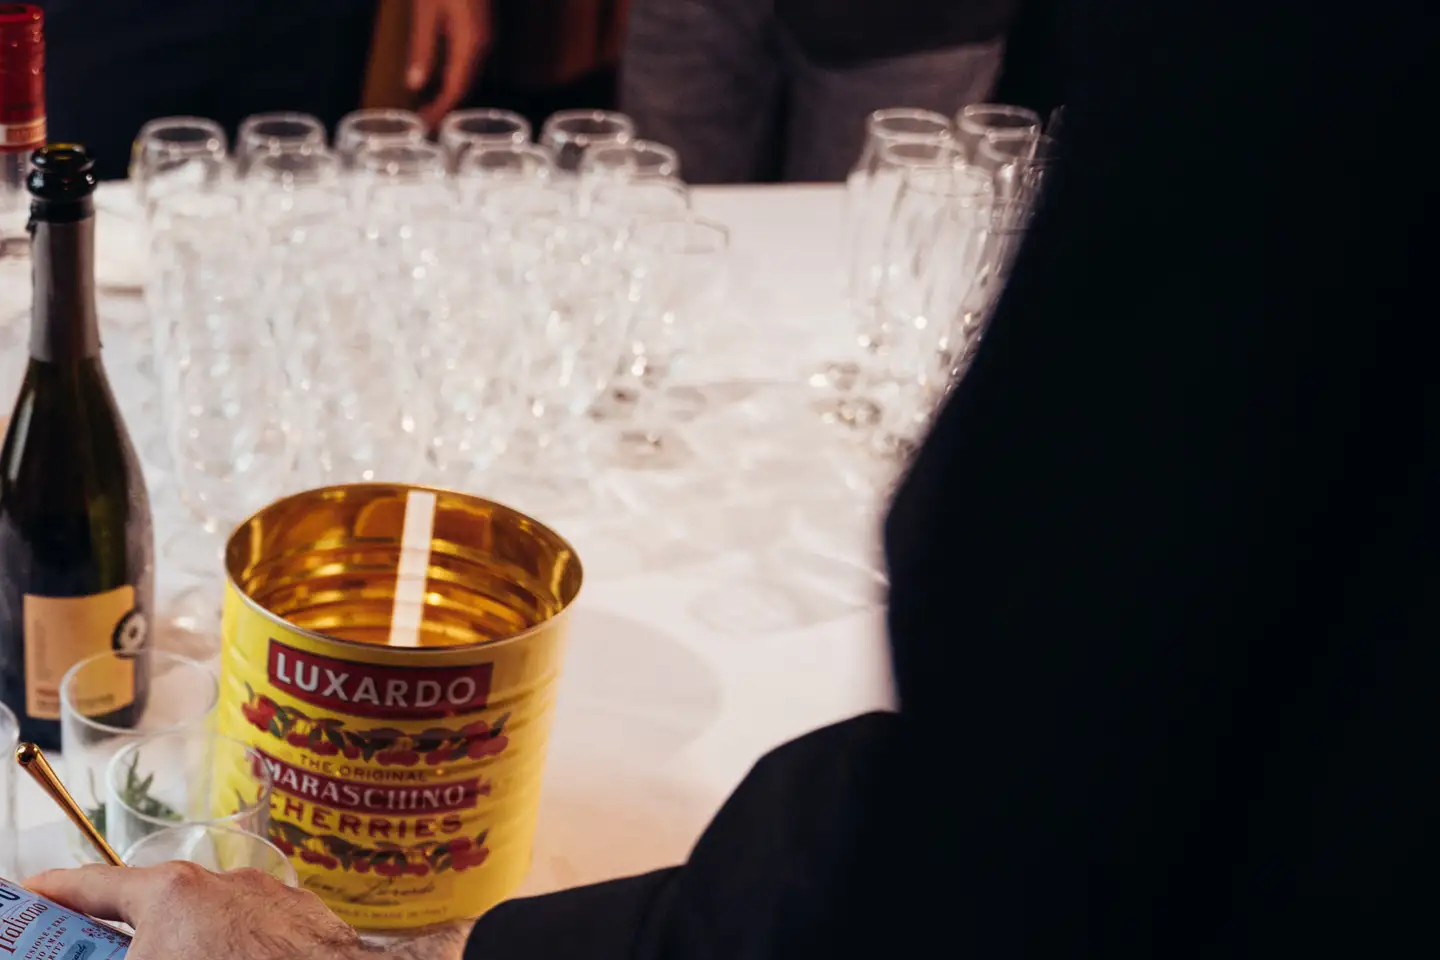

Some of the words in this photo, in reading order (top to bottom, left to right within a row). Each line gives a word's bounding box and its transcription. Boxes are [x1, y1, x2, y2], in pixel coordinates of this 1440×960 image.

[276, 651, 476, 708] LUXARDO
[262, 757, 465, 811] MARASCHINO
[300, 753, 332, 773] THE
[339, 764, 426, 783] ORIGINAL
